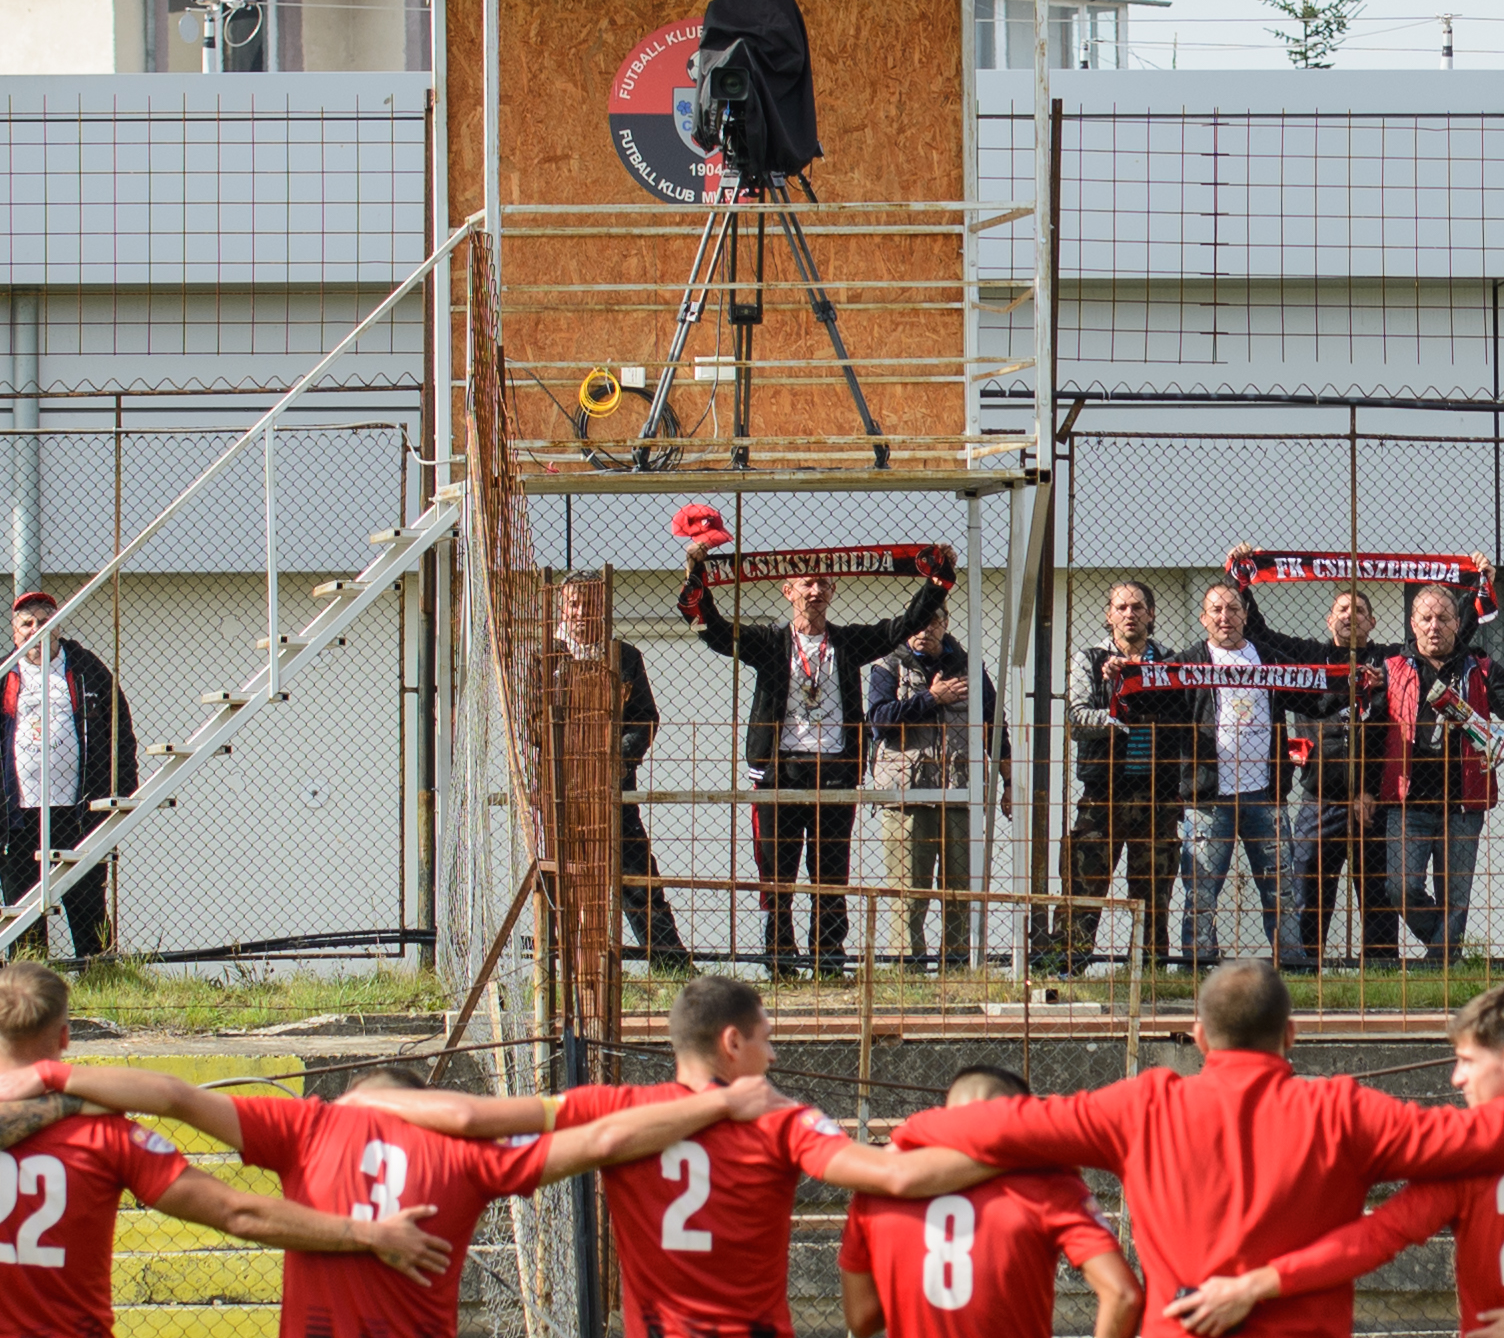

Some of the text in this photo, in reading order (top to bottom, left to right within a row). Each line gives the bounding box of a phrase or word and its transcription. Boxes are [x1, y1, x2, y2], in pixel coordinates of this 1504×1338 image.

[619, 40, 665, 100] FUTBALL
[619, 129, 695, 202] FUTBALL KLUB
[689, 163, 723, 177] 1904
[704, 558, 736, 583] FK
[1274, 557, 1306, 579] FK
[1140, 664, 1172, 688] FK
[351, 1139, 408, 1223] 3
[660, 1141, 712, 1252] 2
[924, 1195, 975, 1310] 8
